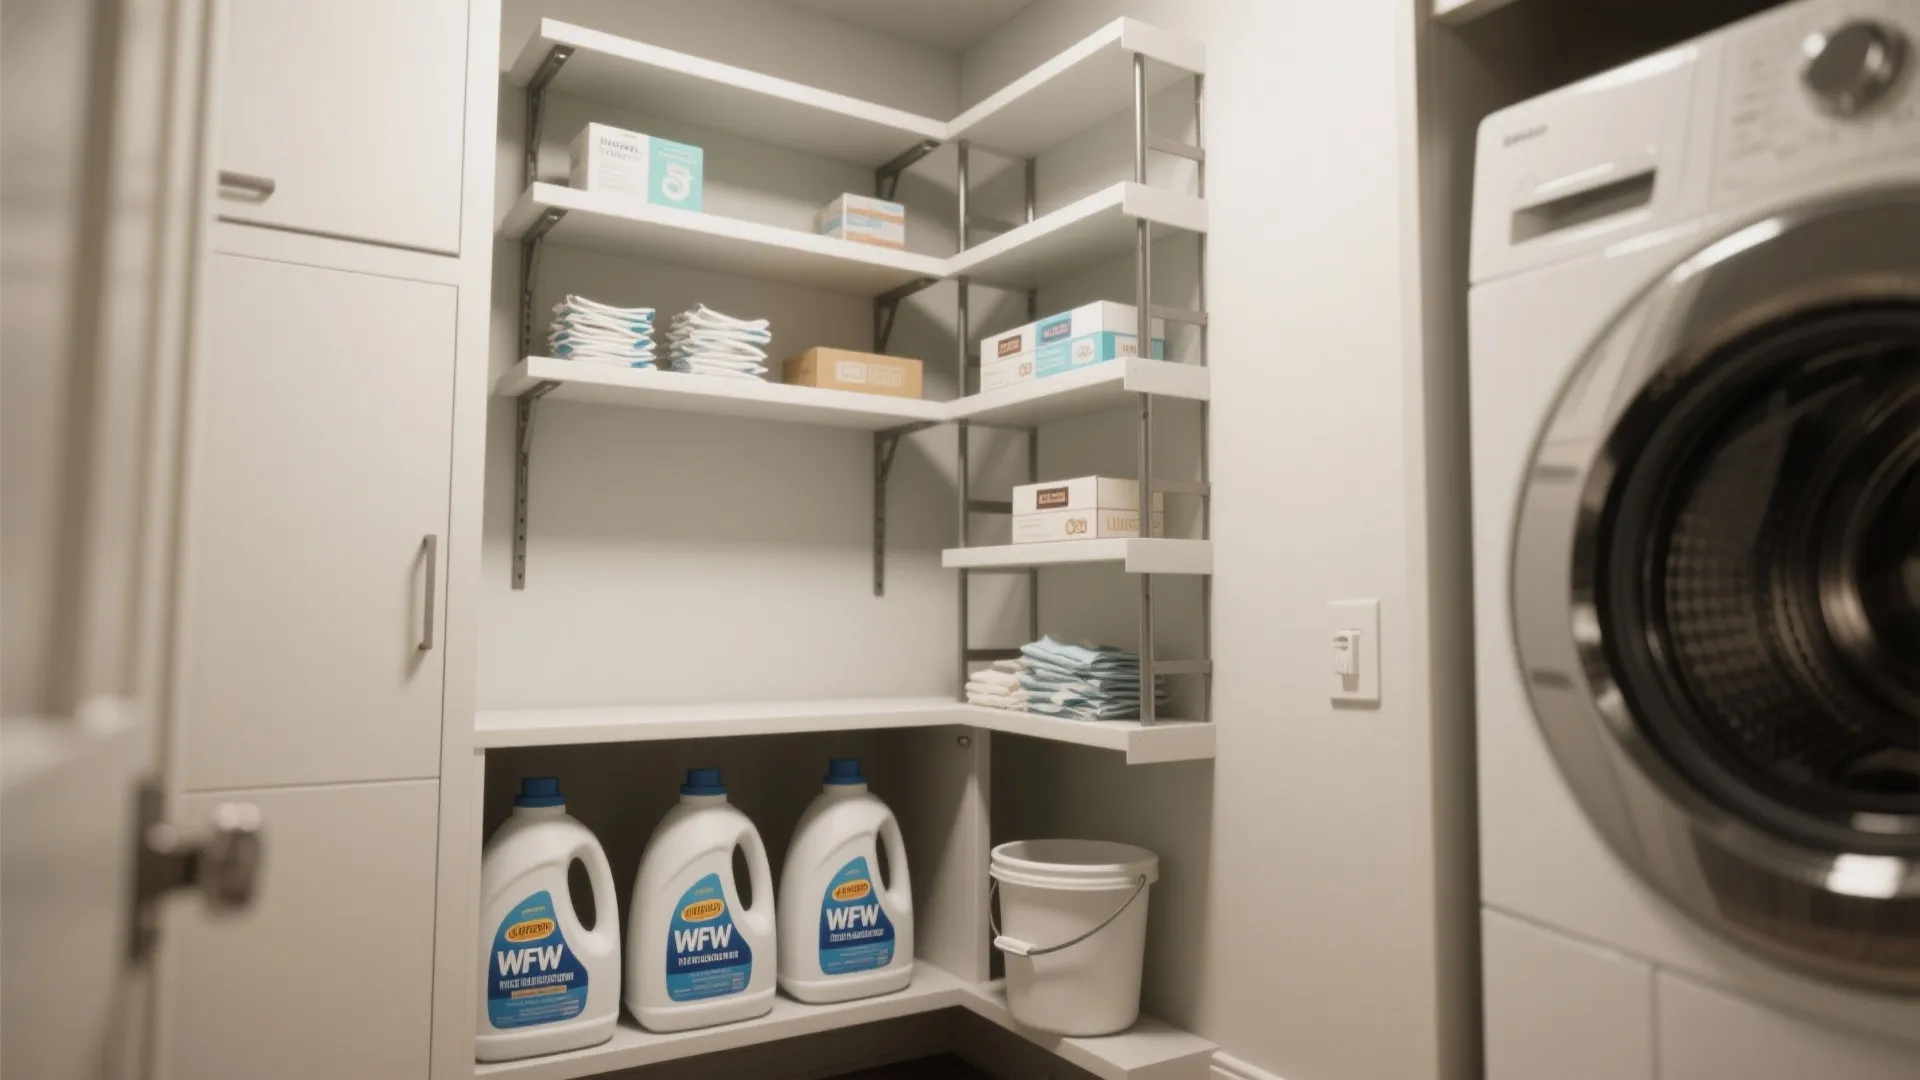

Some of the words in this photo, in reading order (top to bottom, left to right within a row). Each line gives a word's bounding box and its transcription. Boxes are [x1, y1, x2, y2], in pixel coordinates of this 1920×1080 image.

[825, 903, 879, 931] WFW
[674, 923, 732, 954] WFW
[496, 943, 564, 977] WFW
